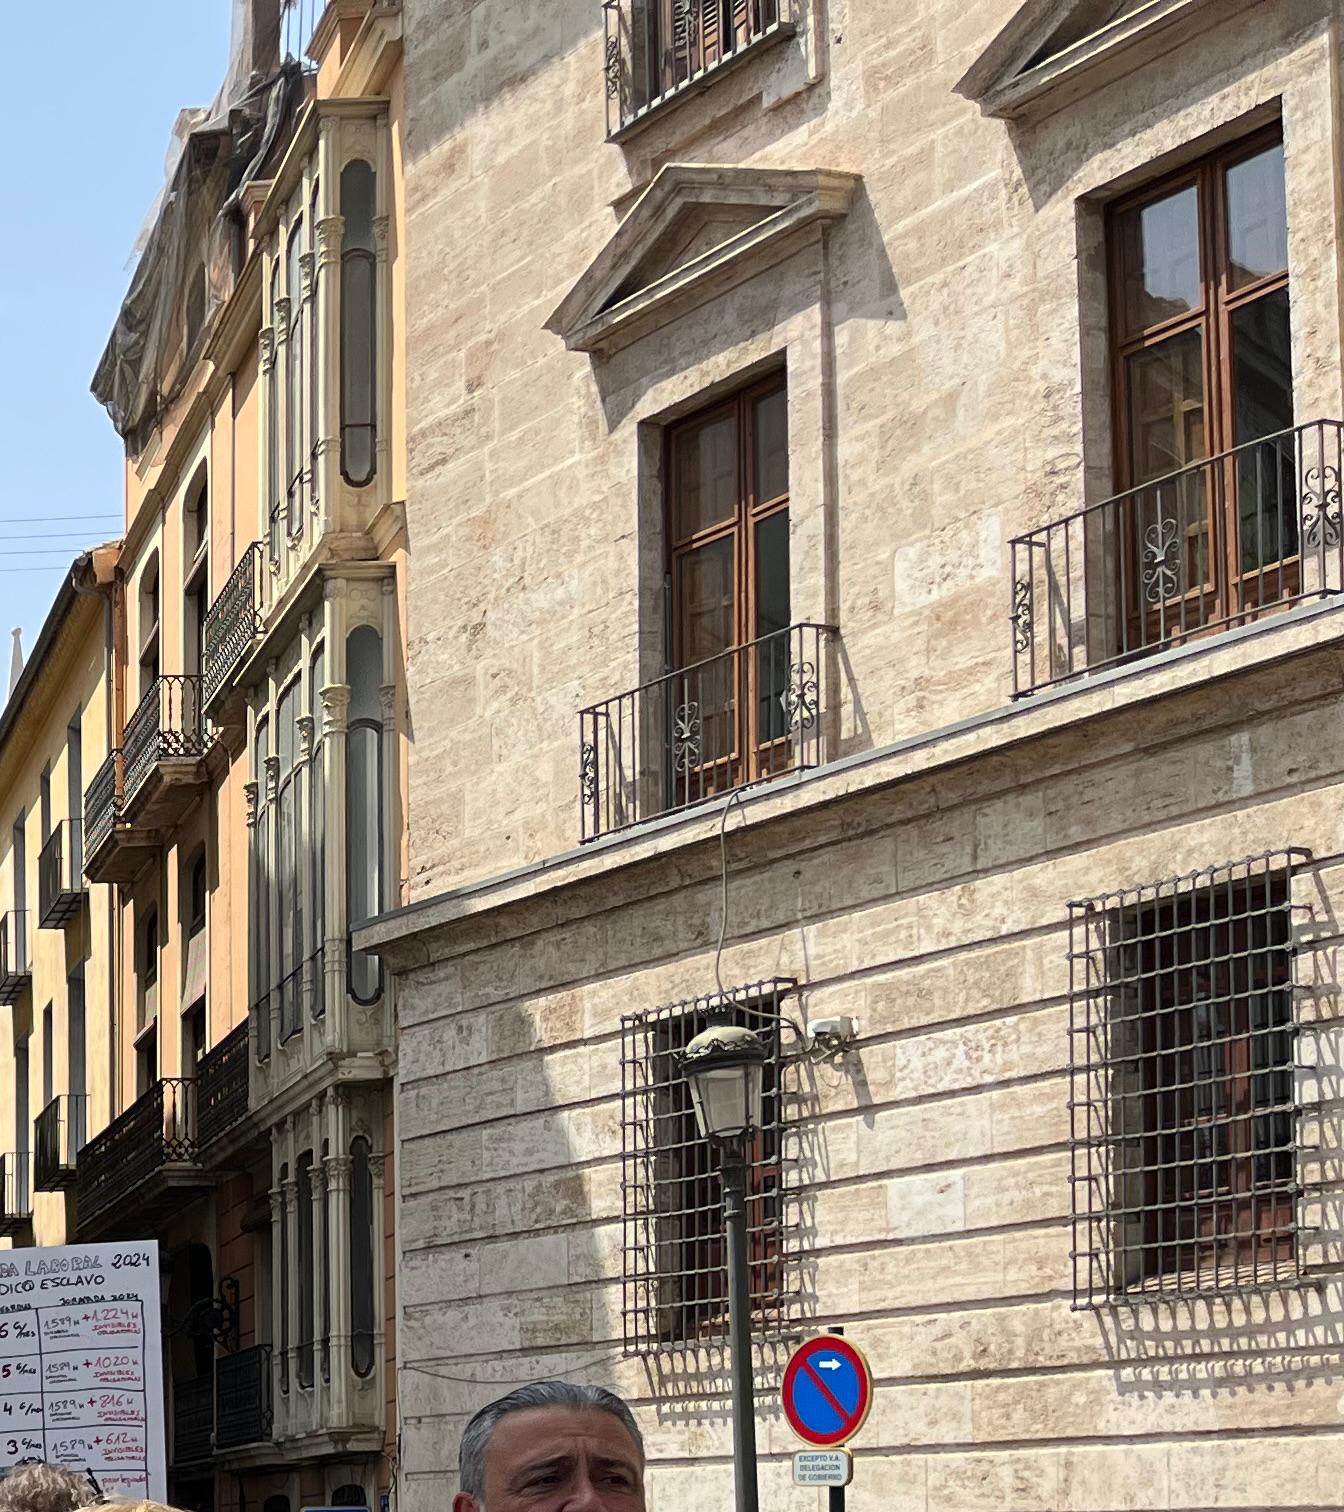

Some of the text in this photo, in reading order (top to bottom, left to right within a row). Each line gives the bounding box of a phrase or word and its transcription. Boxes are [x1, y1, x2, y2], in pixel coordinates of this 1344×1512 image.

[25, 1255, 104, 1277] LABORAL
[111, 1252, 151, 1270] 2024
[40, 1274, 105, 1291] ESCLAVO
[1, 1363, 12, 1379] 5
[3, 1401, 13, 1416] 4
[6, 1438, 19, 1455] 3
[798, 1454, 828, 1463] EXCEPTO
[808, 1473, 843, 1481] GOBIERNO
